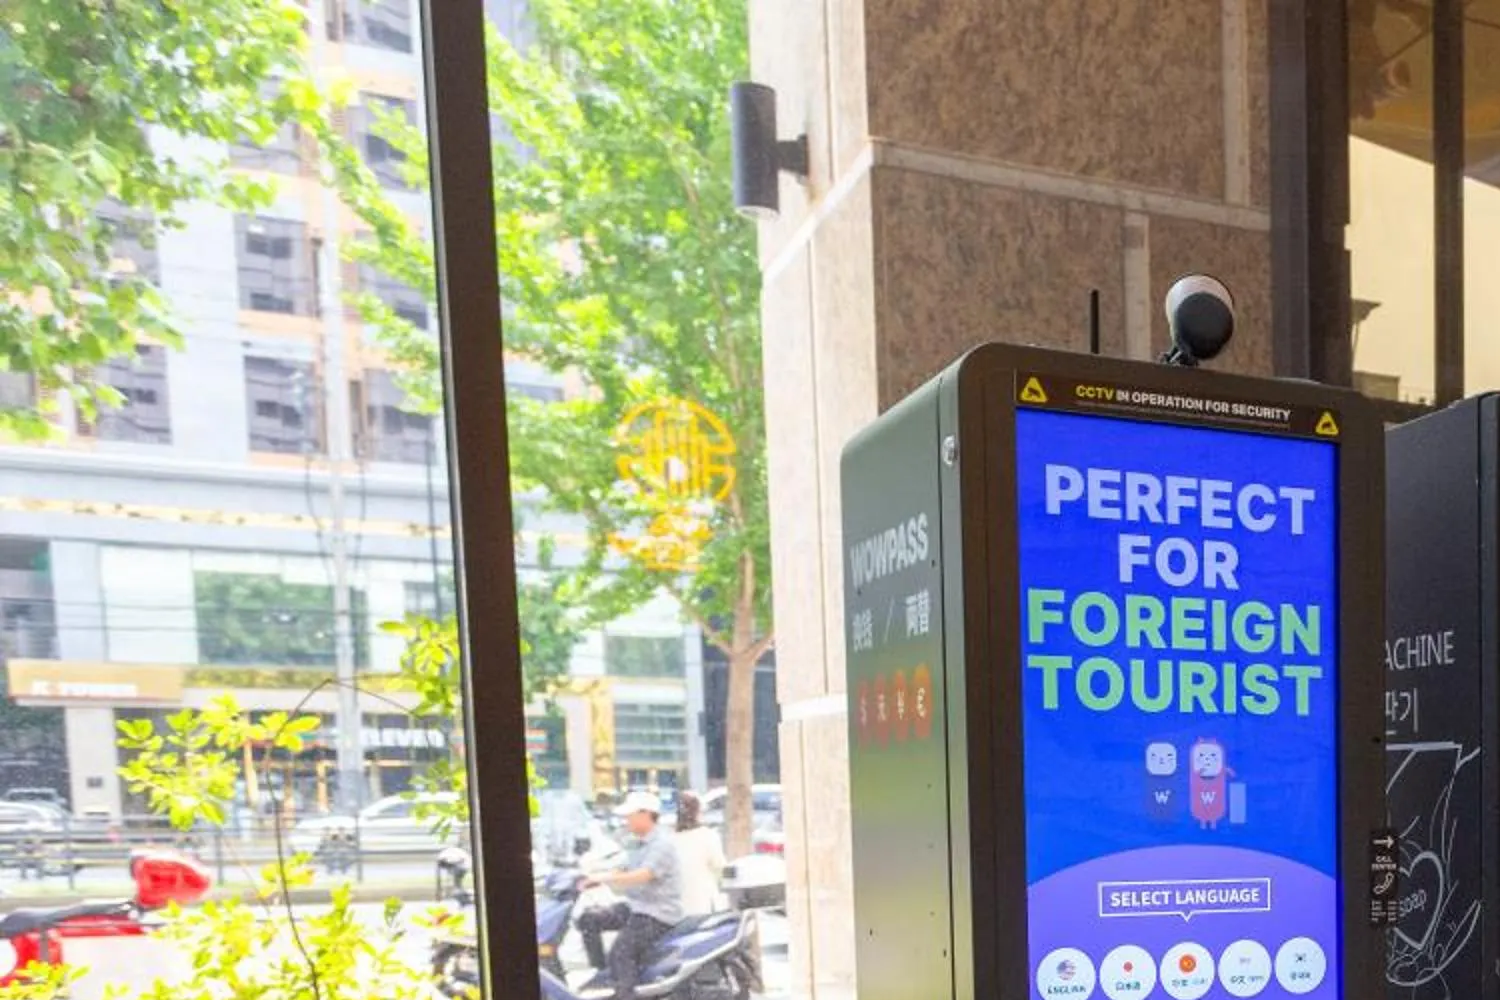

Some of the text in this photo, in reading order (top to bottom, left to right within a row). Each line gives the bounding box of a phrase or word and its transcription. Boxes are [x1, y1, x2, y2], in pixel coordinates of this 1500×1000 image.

[1075, 385, 1291, 421] CCTV IN OPERATION FOR SECURITY
[1045, 463, 1315, 535] PERFECT
[851, 511, 928, 590] WOWPASS
[1119, 533, 1240, 591] FOR
[1027, 587, 1321, 656] FOREIGN
[1027, 654, 1323, 717] TOURIST
[1110, 887, 1260, 908] SELECT LANGUAGE
